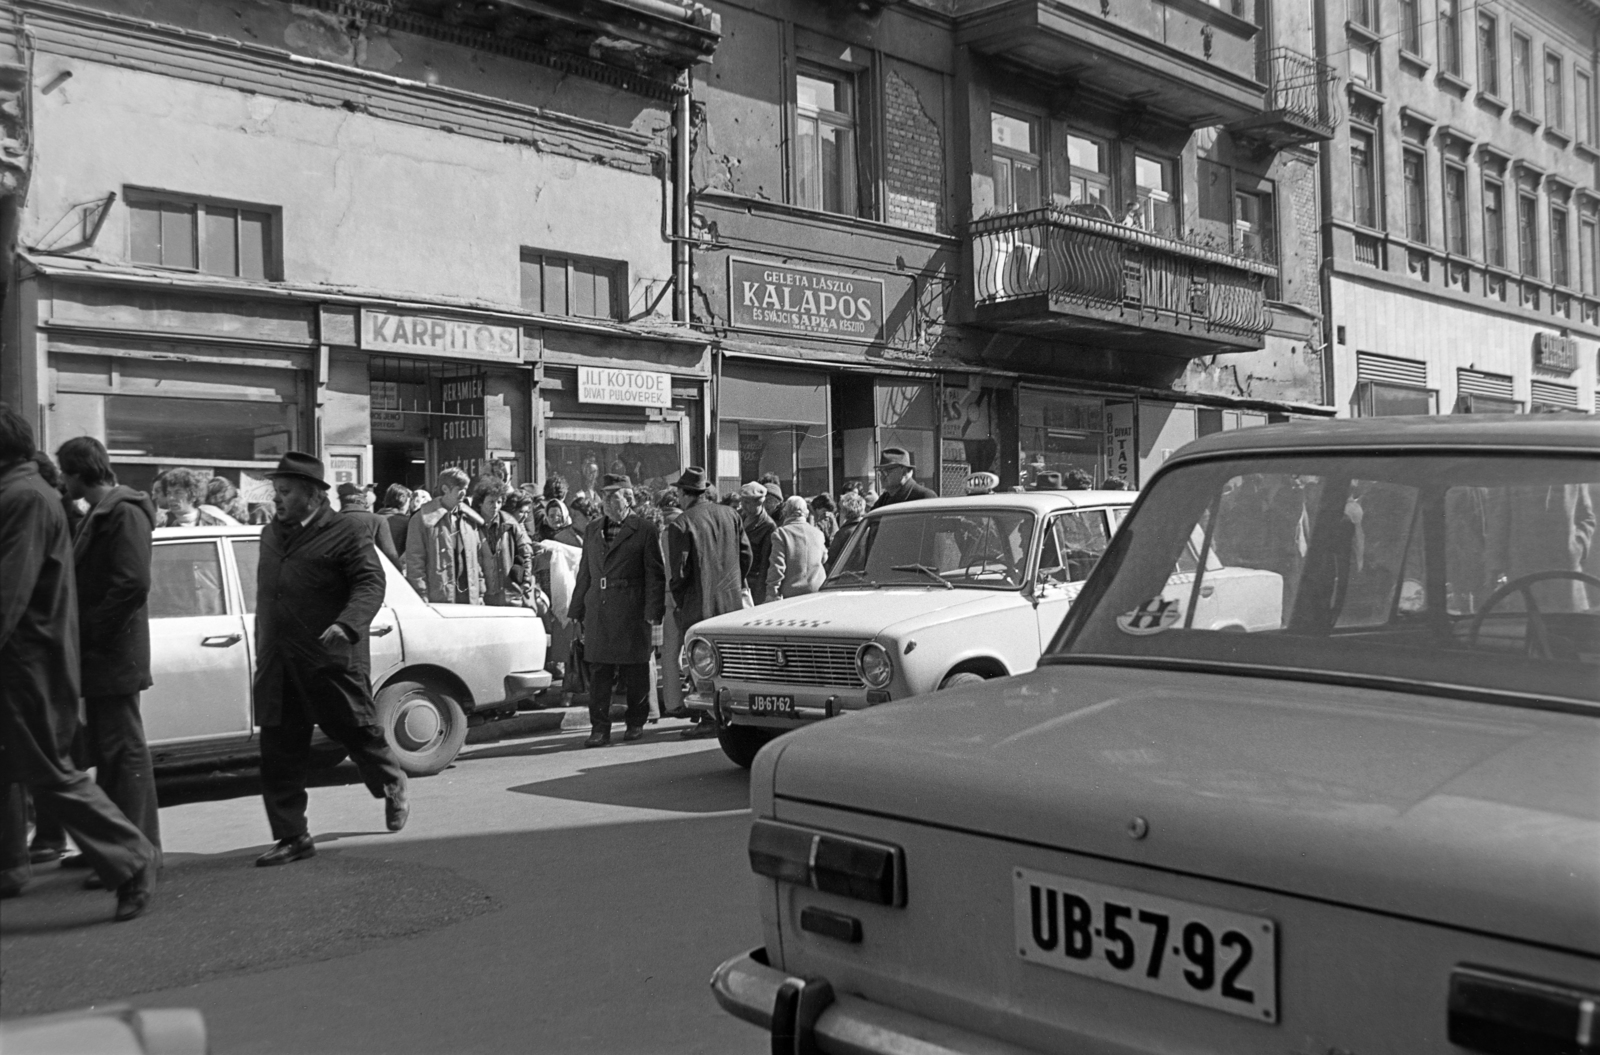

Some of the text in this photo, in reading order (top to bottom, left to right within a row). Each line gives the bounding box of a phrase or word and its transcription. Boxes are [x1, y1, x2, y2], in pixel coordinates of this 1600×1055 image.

[764, 270, 854, 294] GELETA LÁSZLÓ
[742, 281, 872, 321] KALAPOS
[752, 307, 763, 321] ÉS
[791, 313, 838, 329] SAPKA
[792, 324, 829, 333] MESTER
[443, 378, 484, 402] REKAMIÉK
[583, 387, 606, 401] DIVAT
[443, 419, 484, 441] FOTELOK
[1114, 427, 1132, 437] DIVAT
[1117, 439, 1128, 480] TAS
[967, 475, 989, 488] TAXI
